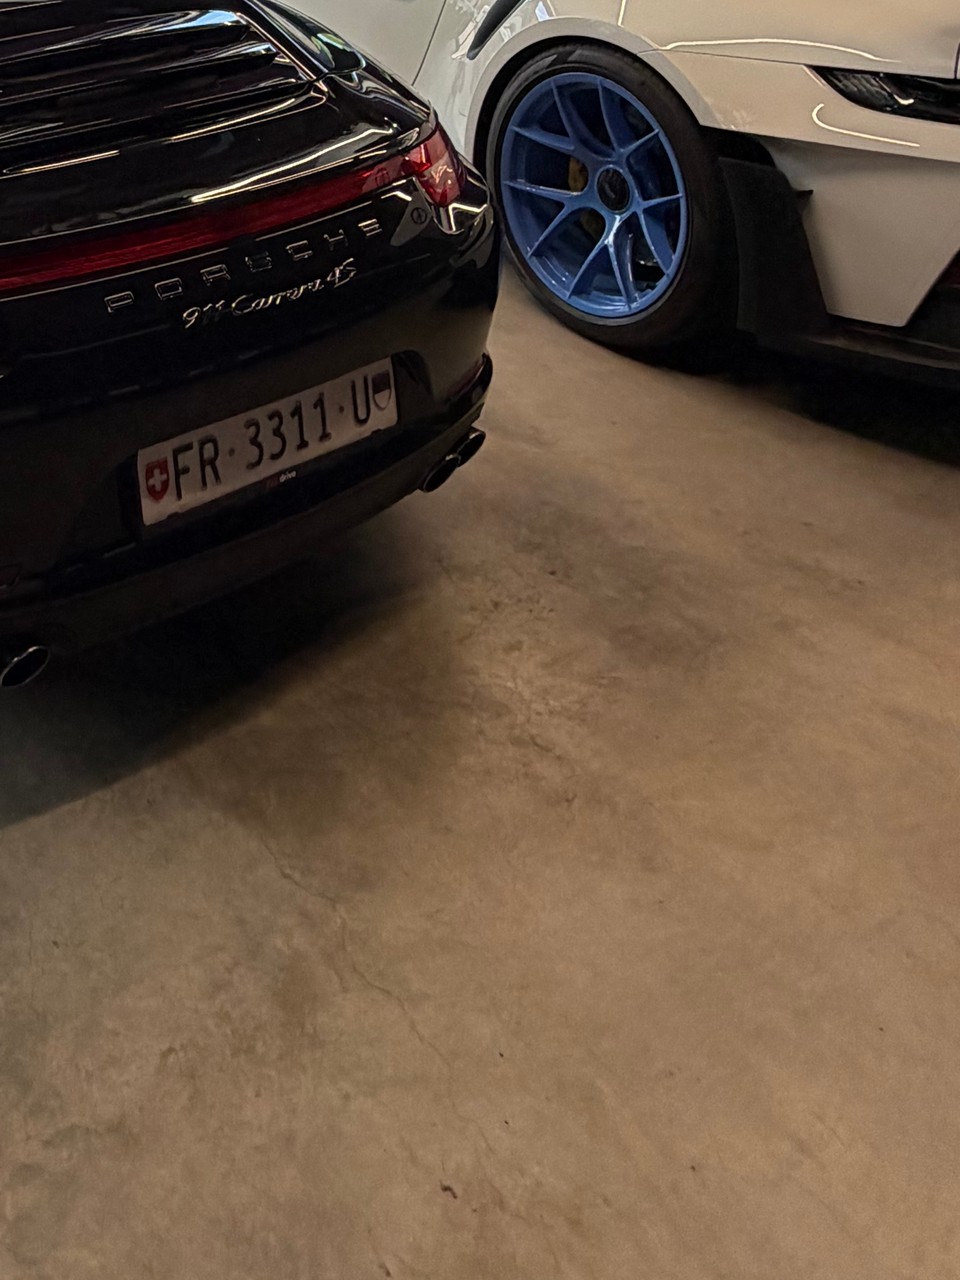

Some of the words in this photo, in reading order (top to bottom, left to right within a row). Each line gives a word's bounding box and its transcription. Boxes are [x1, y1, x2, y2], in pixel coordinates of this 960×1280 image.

[104, 218, 383, 313] PORSCHE
[182, 299, 226, 328] 911
[230, 277, 326, 316] Carrera
[326, 257, 358, 288] 4S
[171, 433, 222, 501] FR
[243, 391, 332, 470] 3311
[350, 374, 372, 427] U
